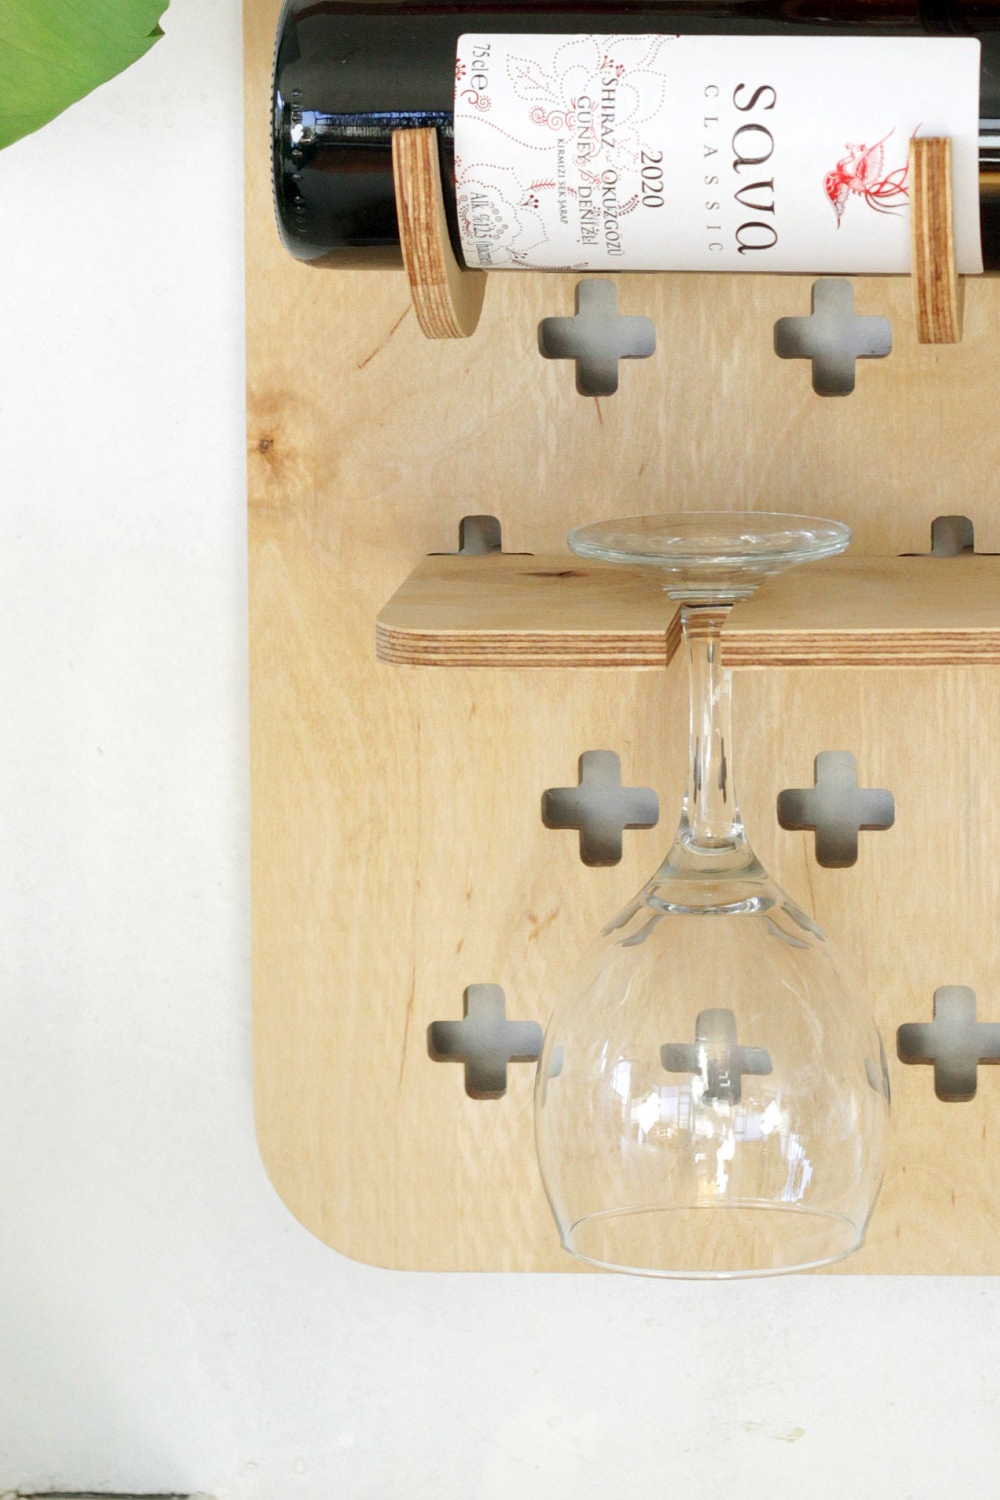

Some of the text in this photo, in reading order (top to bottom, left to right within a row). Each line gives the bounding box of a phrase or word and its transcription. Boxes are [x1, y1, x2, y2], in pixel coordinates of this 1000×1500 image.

[601, 77, 619, 149] SHIRAZ
[558, 181, 568, 197] SEK
[640, 150, 665, 209] 2020
[702, 83, 724, 254] CLASSIC
[731, 82, 778, 255] sava
[557, 199, 569, 225] ŞARAP
